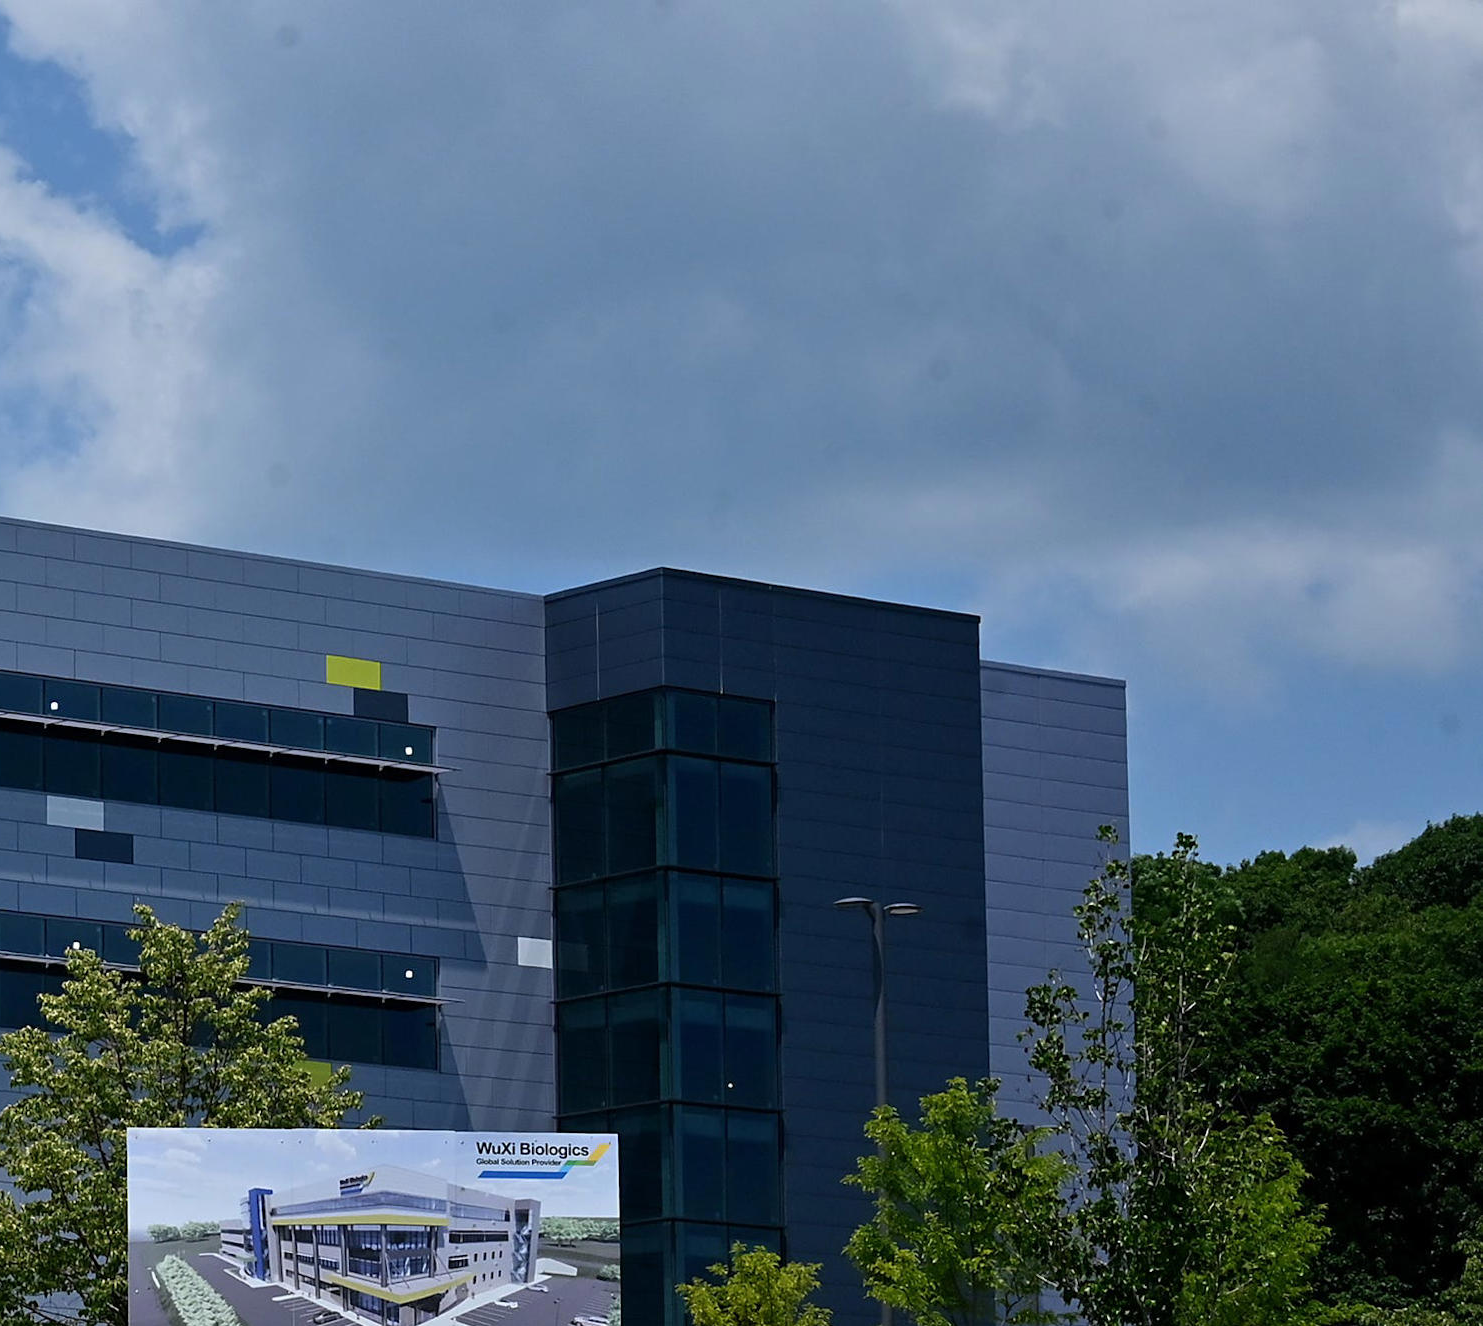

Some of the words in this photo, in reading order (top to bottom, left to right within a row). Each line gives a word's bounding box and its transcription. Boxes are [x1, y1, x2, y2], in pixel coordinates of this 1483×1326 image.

[476, 1142, 515, 1155] WuXi
[520, 1142, 589, 1159] Biologics
[476, 1158, 499, 1166] Global
[532, 1159, 562, 1167] Provider
